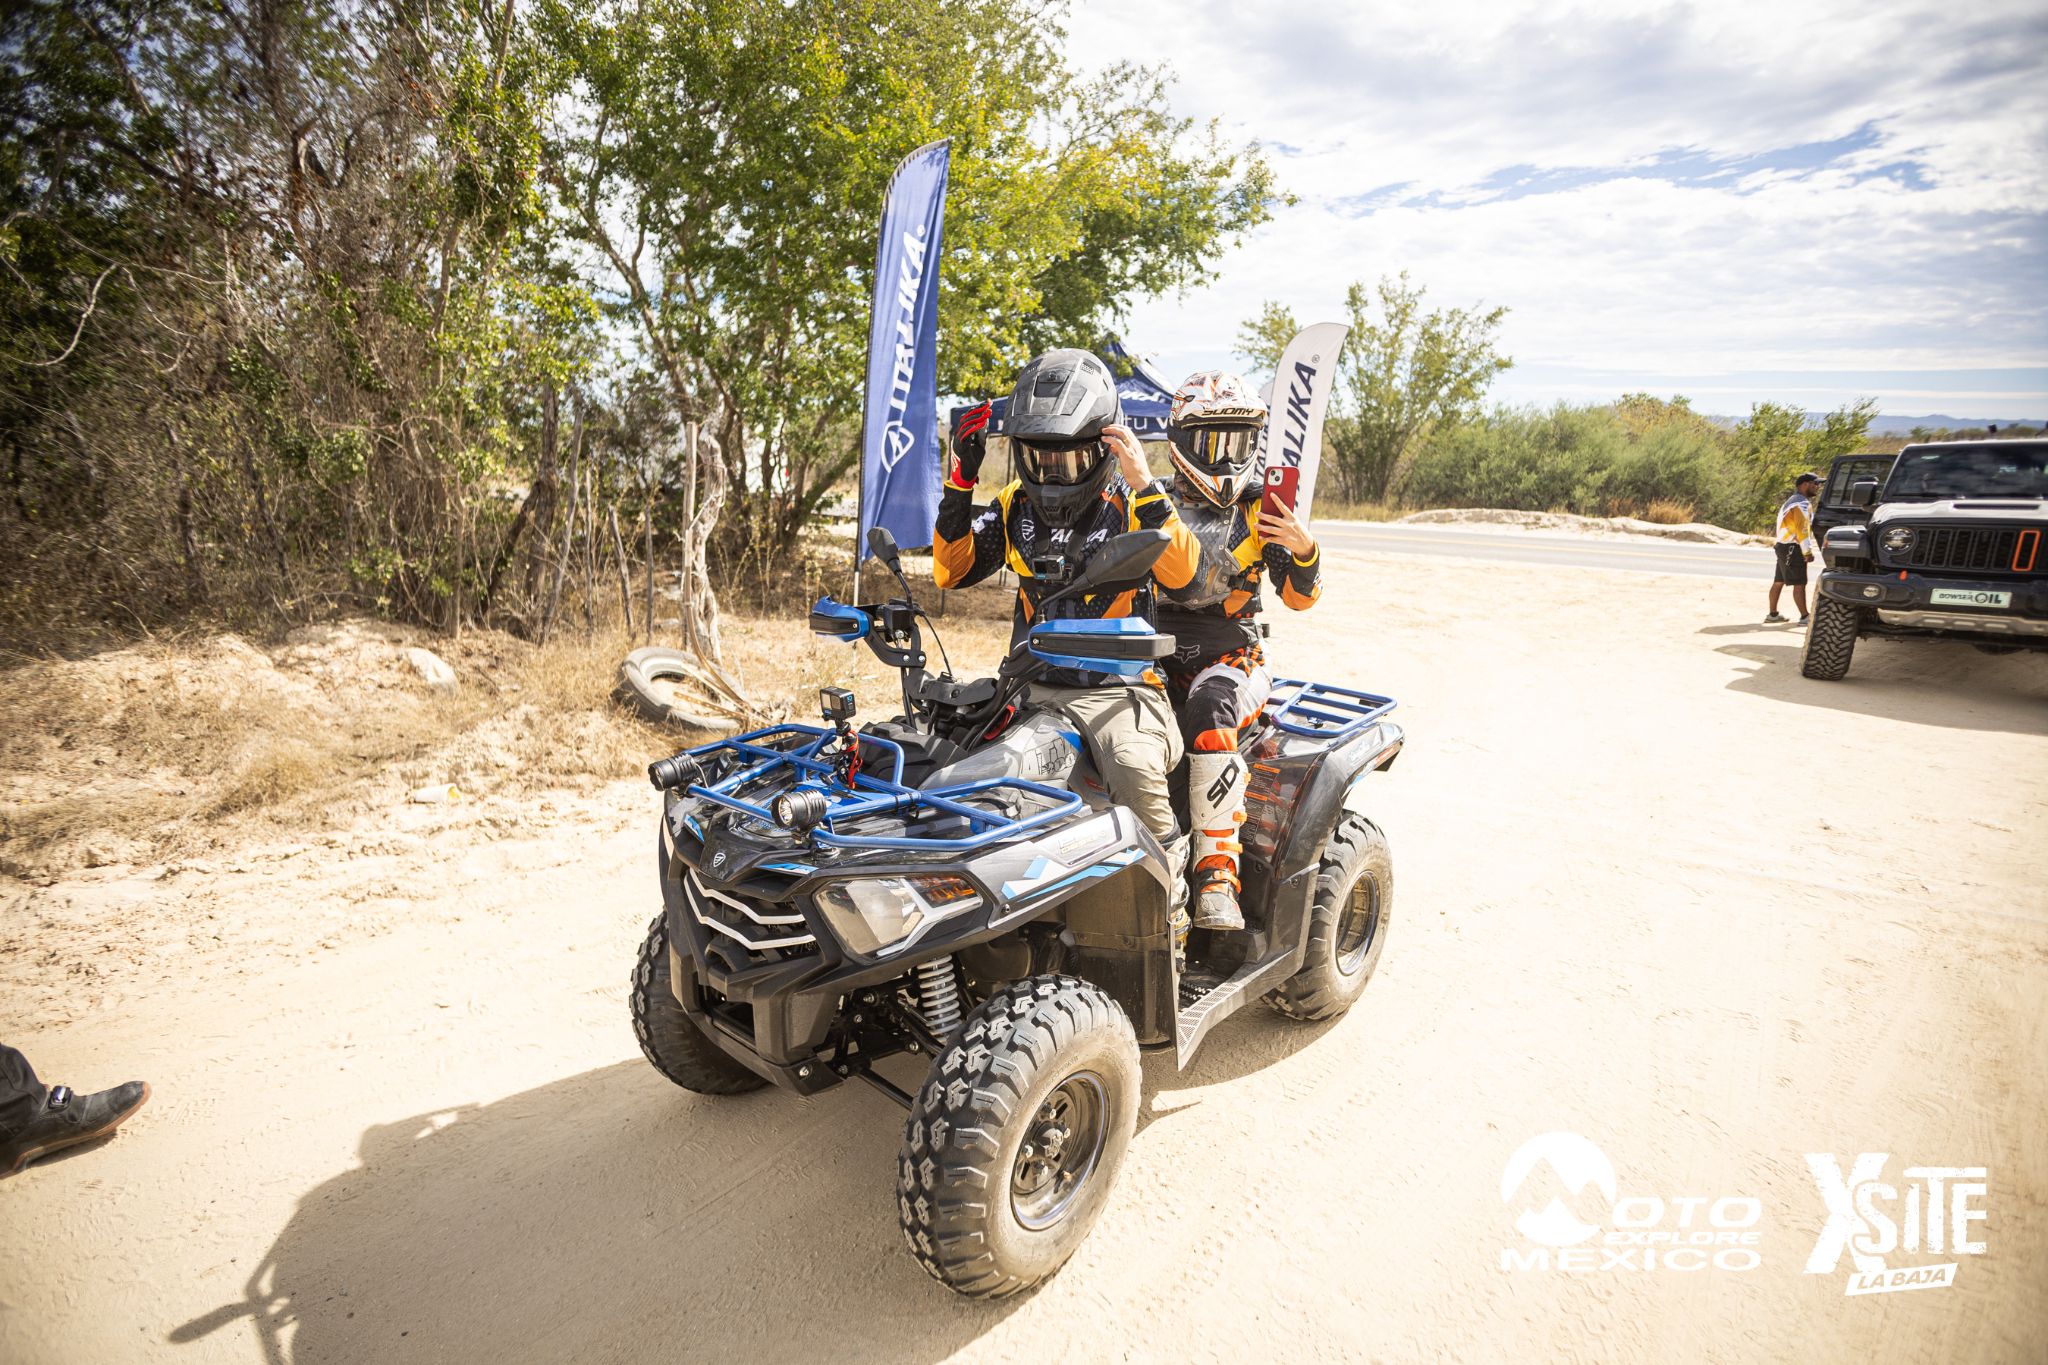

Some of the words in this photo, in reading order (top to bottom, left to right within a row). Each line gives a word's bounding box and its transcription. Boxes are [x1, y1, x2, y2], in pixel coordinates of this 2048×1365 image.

[890, 231, 927, 413] ITALIKA
[1201, 407, 1254, 416] SUOMY
[1974, 592, 2002, 604] OIL
